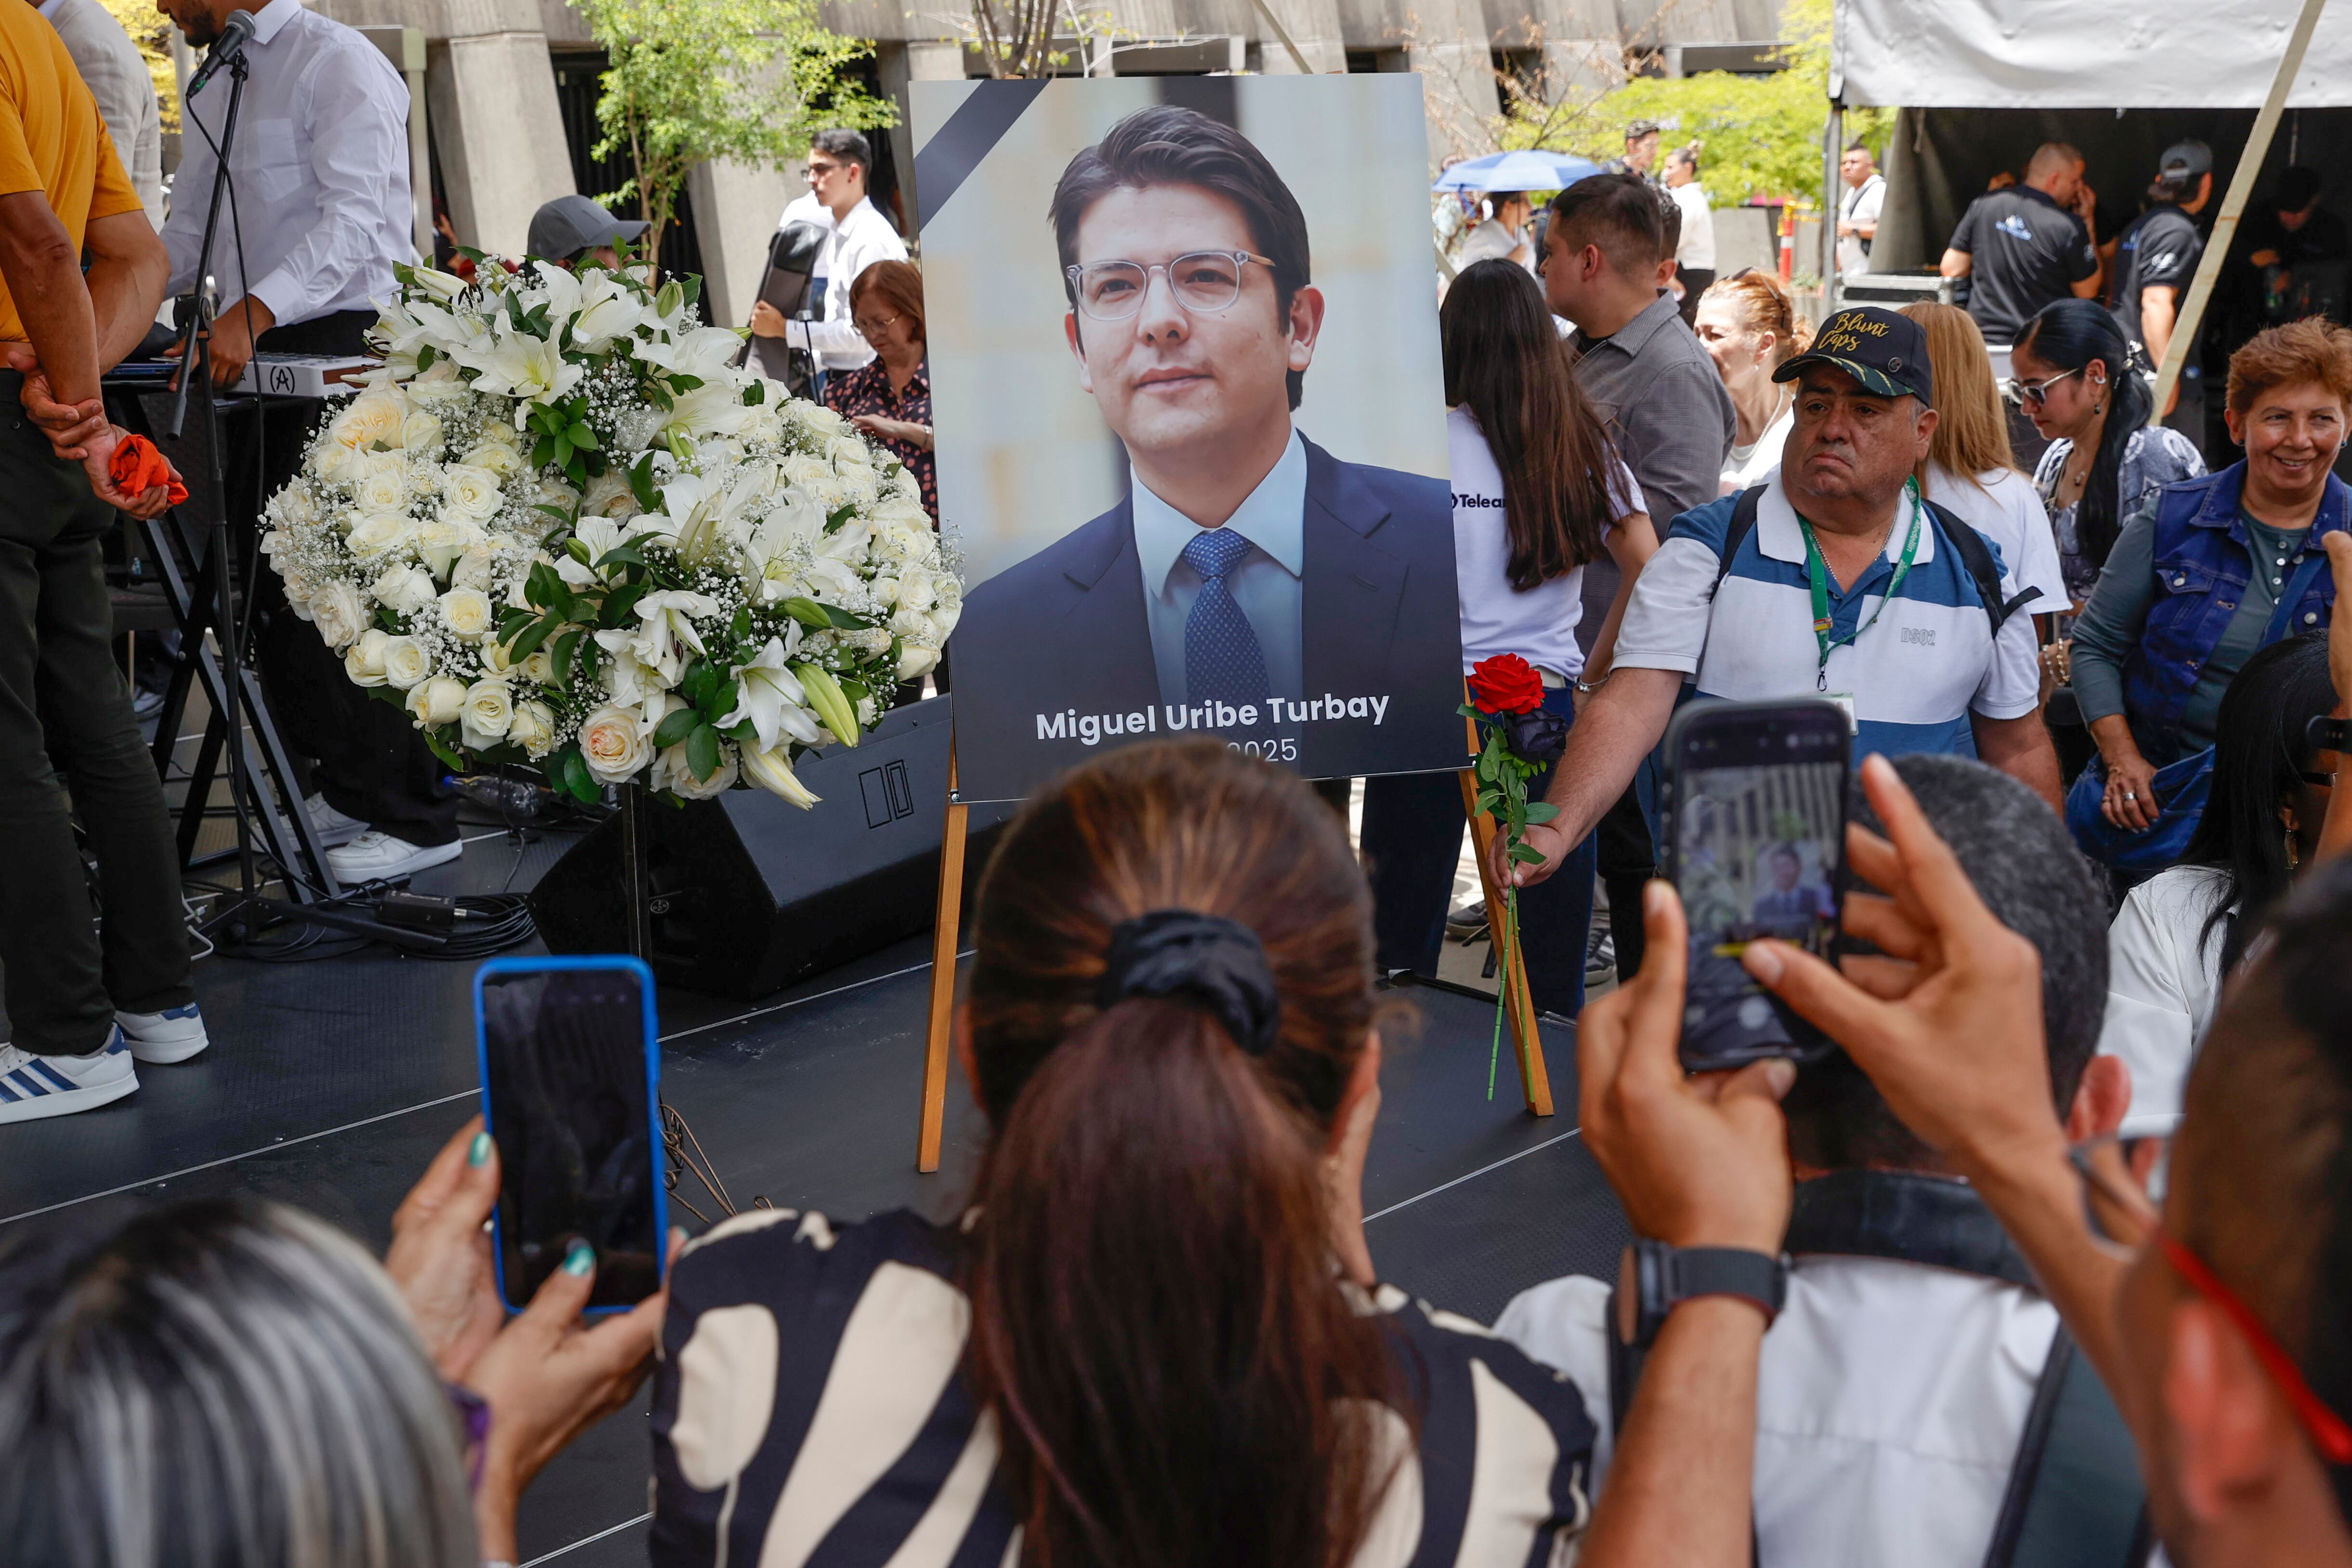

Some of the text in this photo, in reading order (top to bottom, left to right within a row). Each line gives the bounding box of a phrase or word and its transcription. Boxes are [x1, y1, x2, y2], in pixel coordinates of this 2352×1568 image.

[1834, 313, 1890, 338] Blunt
[1817, 329, 1861, 353] Caps
[1901, 628, 1935, 646] DSQ2
[1036, 693, 1390, 746] Miguel Uribe Turbay
